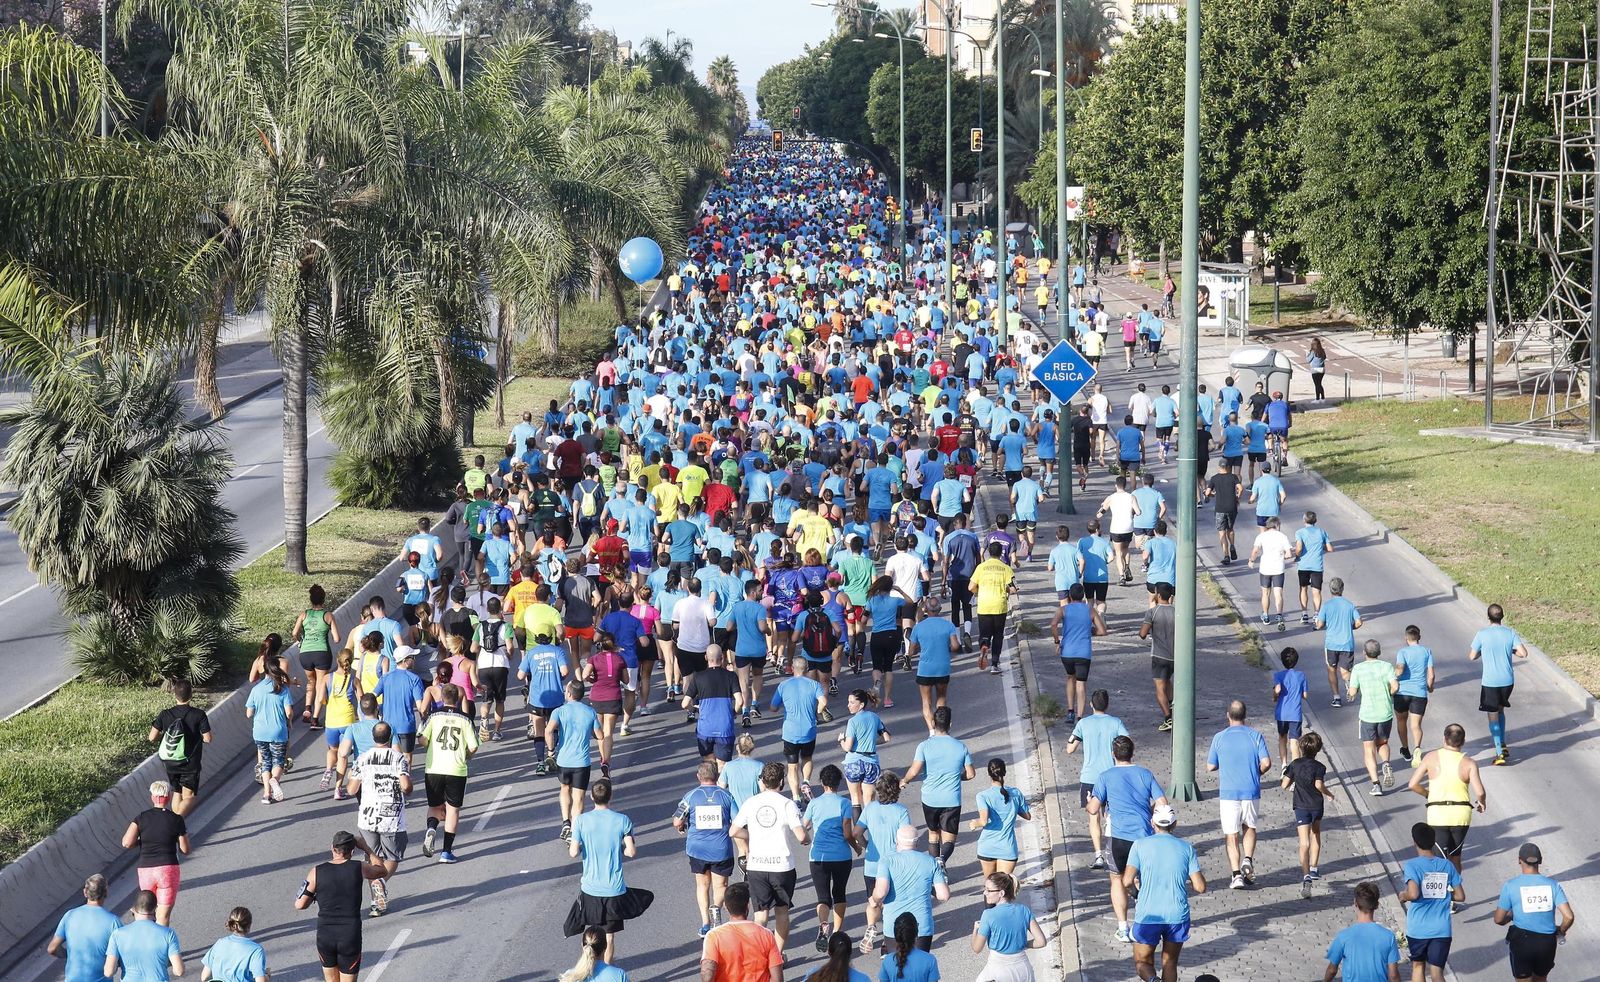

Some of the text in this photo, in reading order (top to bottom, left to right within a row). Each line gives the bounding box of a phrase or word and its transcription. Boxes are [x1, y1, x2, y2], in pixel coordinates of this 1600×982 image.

[1053, 362, 1075, 371] RED
[1044, 371, 1084, 381] BÁSICA
[436, 725, 461, 751] 45
[698, 814, 720, 822] 15981
[1425, 882, 1443, 890] 6900
[1527, 895, 1548, 904] 6734
